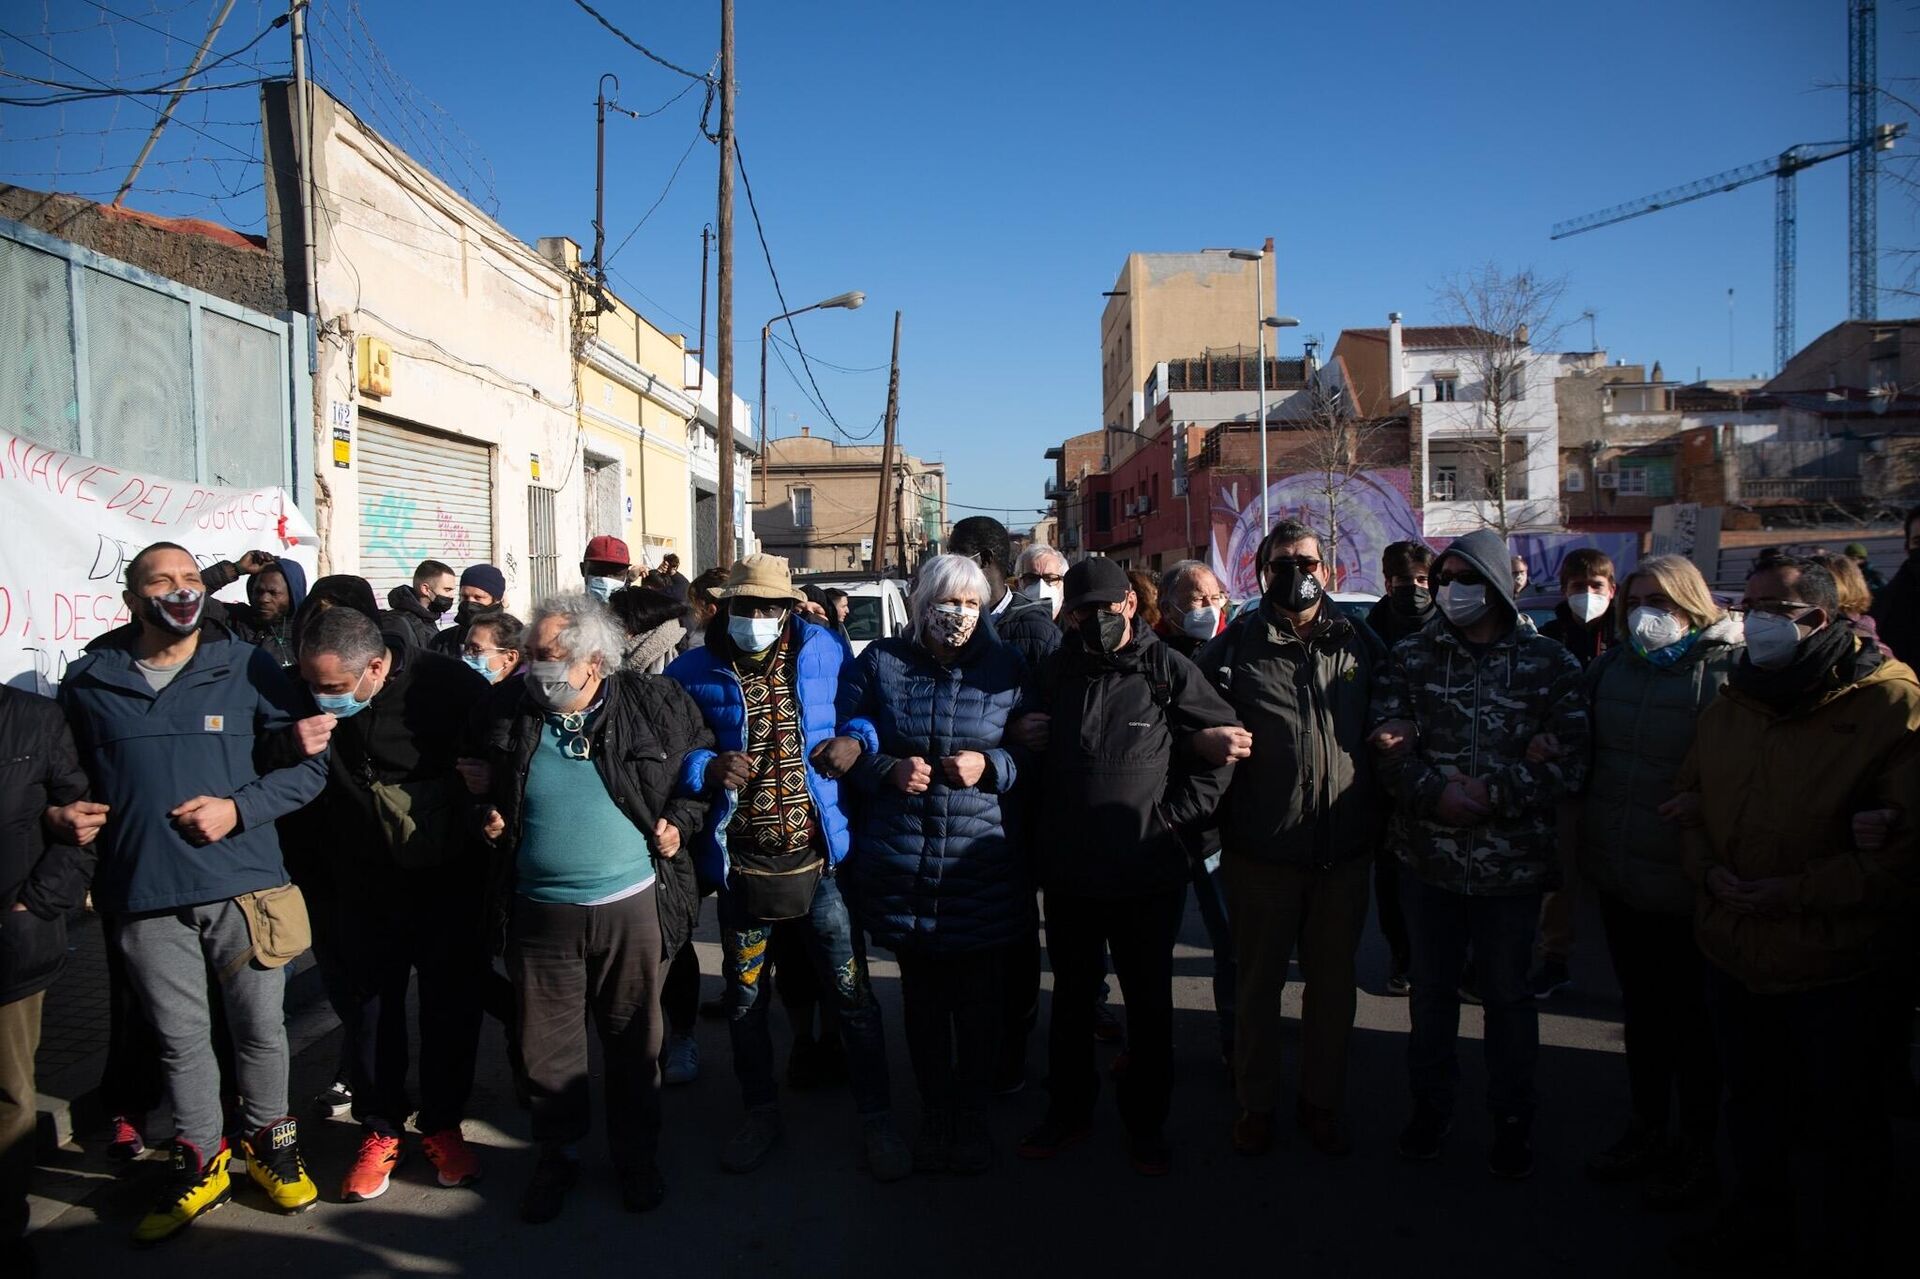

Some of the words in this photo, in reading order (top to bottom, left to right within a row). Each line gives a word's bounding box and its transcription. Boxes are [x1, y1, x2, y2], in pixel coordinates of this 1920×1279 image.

[333, 402, 350, 426] 162
[8, 436, 120, 502] NAVE
[106, 478, 173, 525] DEL
[54, 593, 131, 640] DESA
[272, 1120, 297, 1138] BIG
[272, 1132, 297, 1150] PUN
